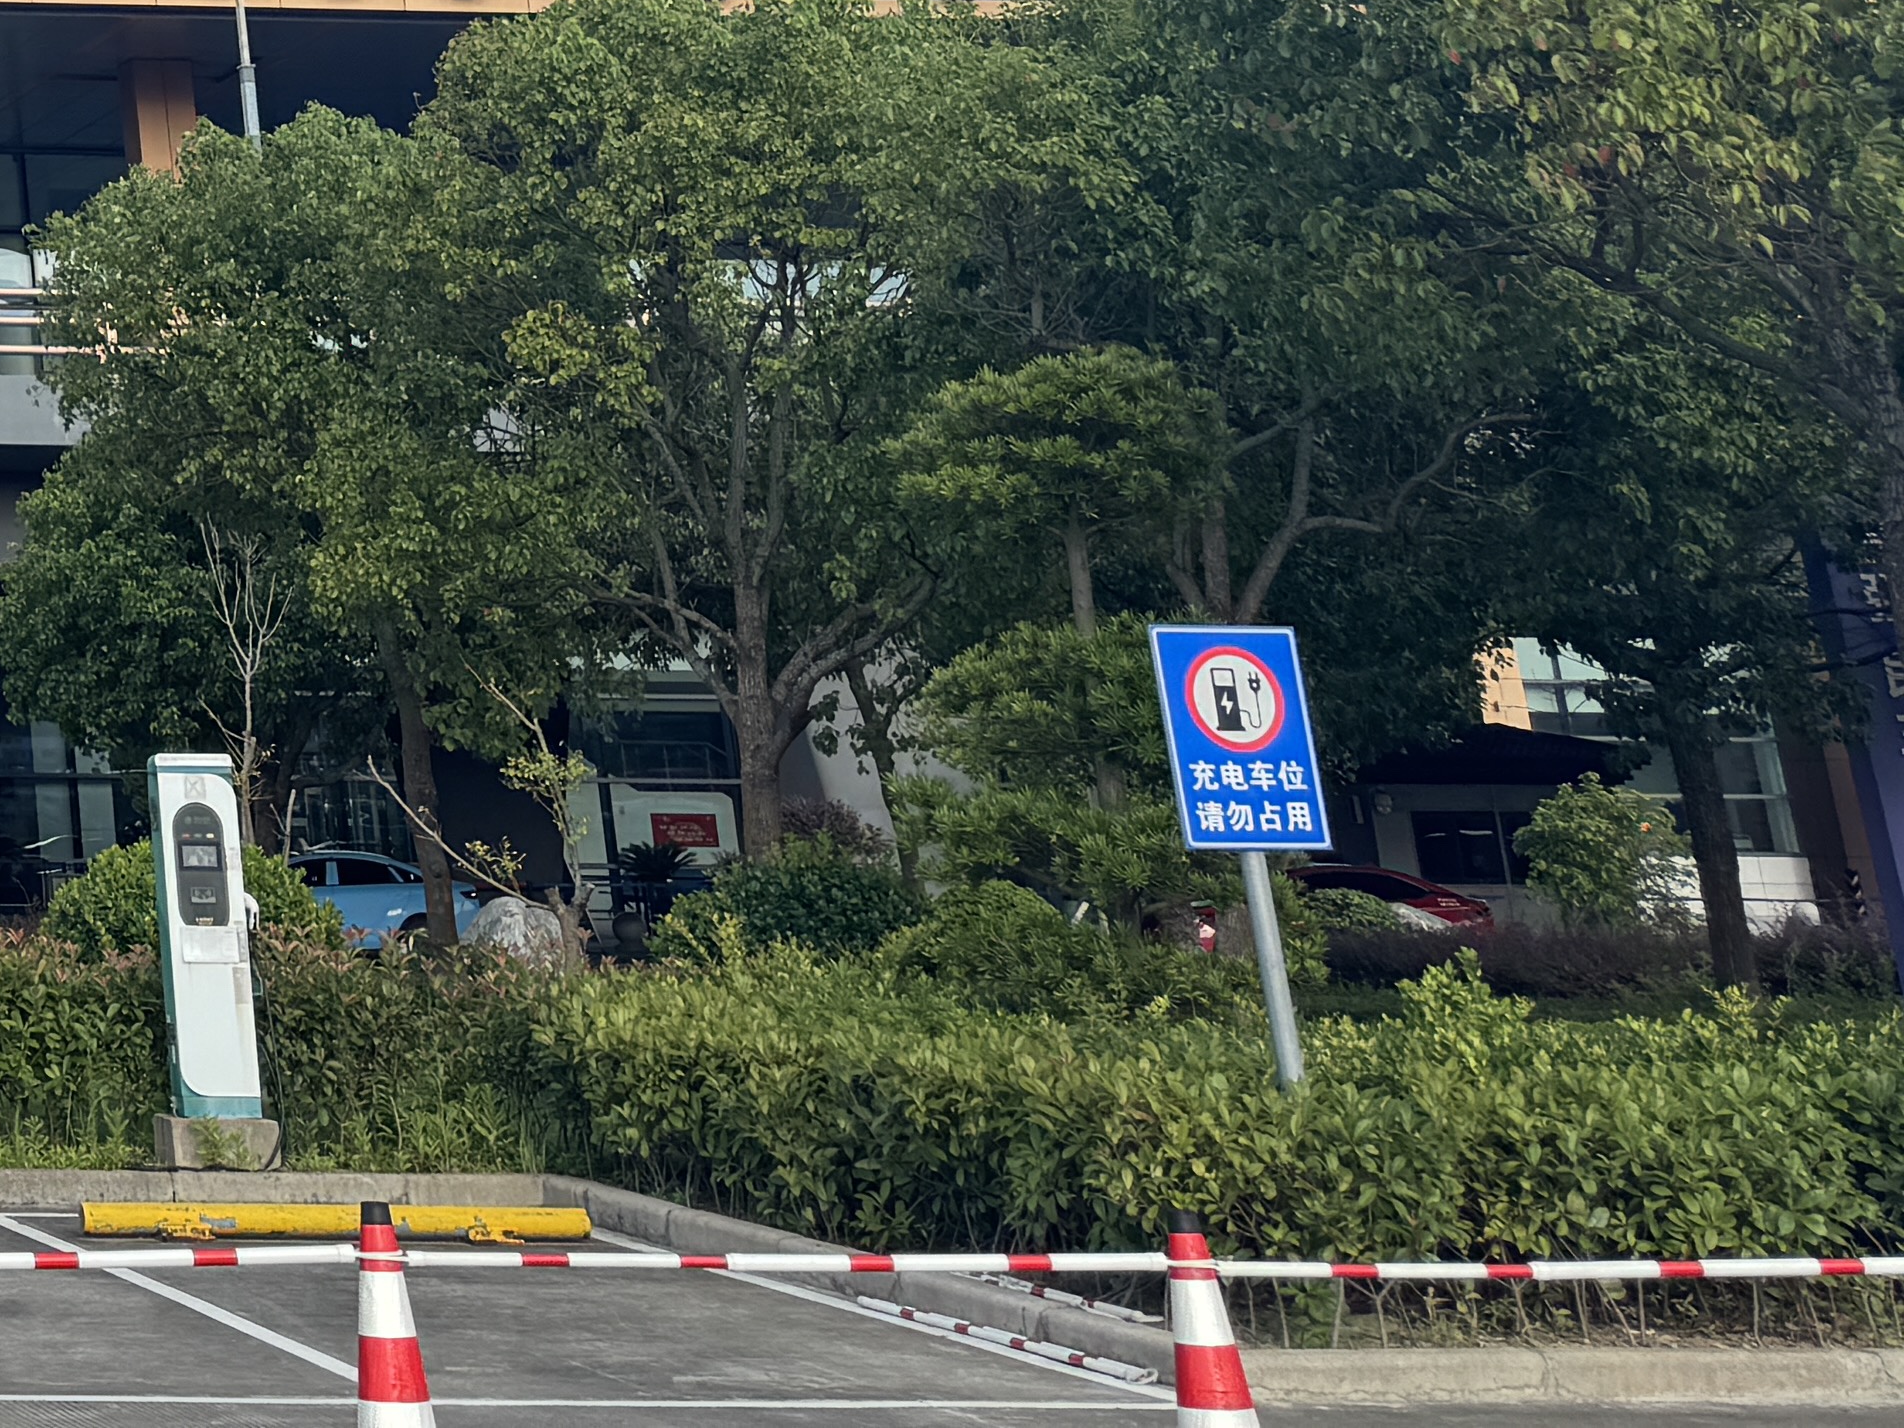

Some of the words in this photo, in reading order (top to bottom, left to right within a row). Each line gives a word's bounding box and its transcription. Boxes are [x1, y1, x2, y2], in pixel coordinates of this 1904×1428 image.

[1188, 760, 1309, 792] 充电车位
[1195, 800, 1314, 833] 请勿占用
